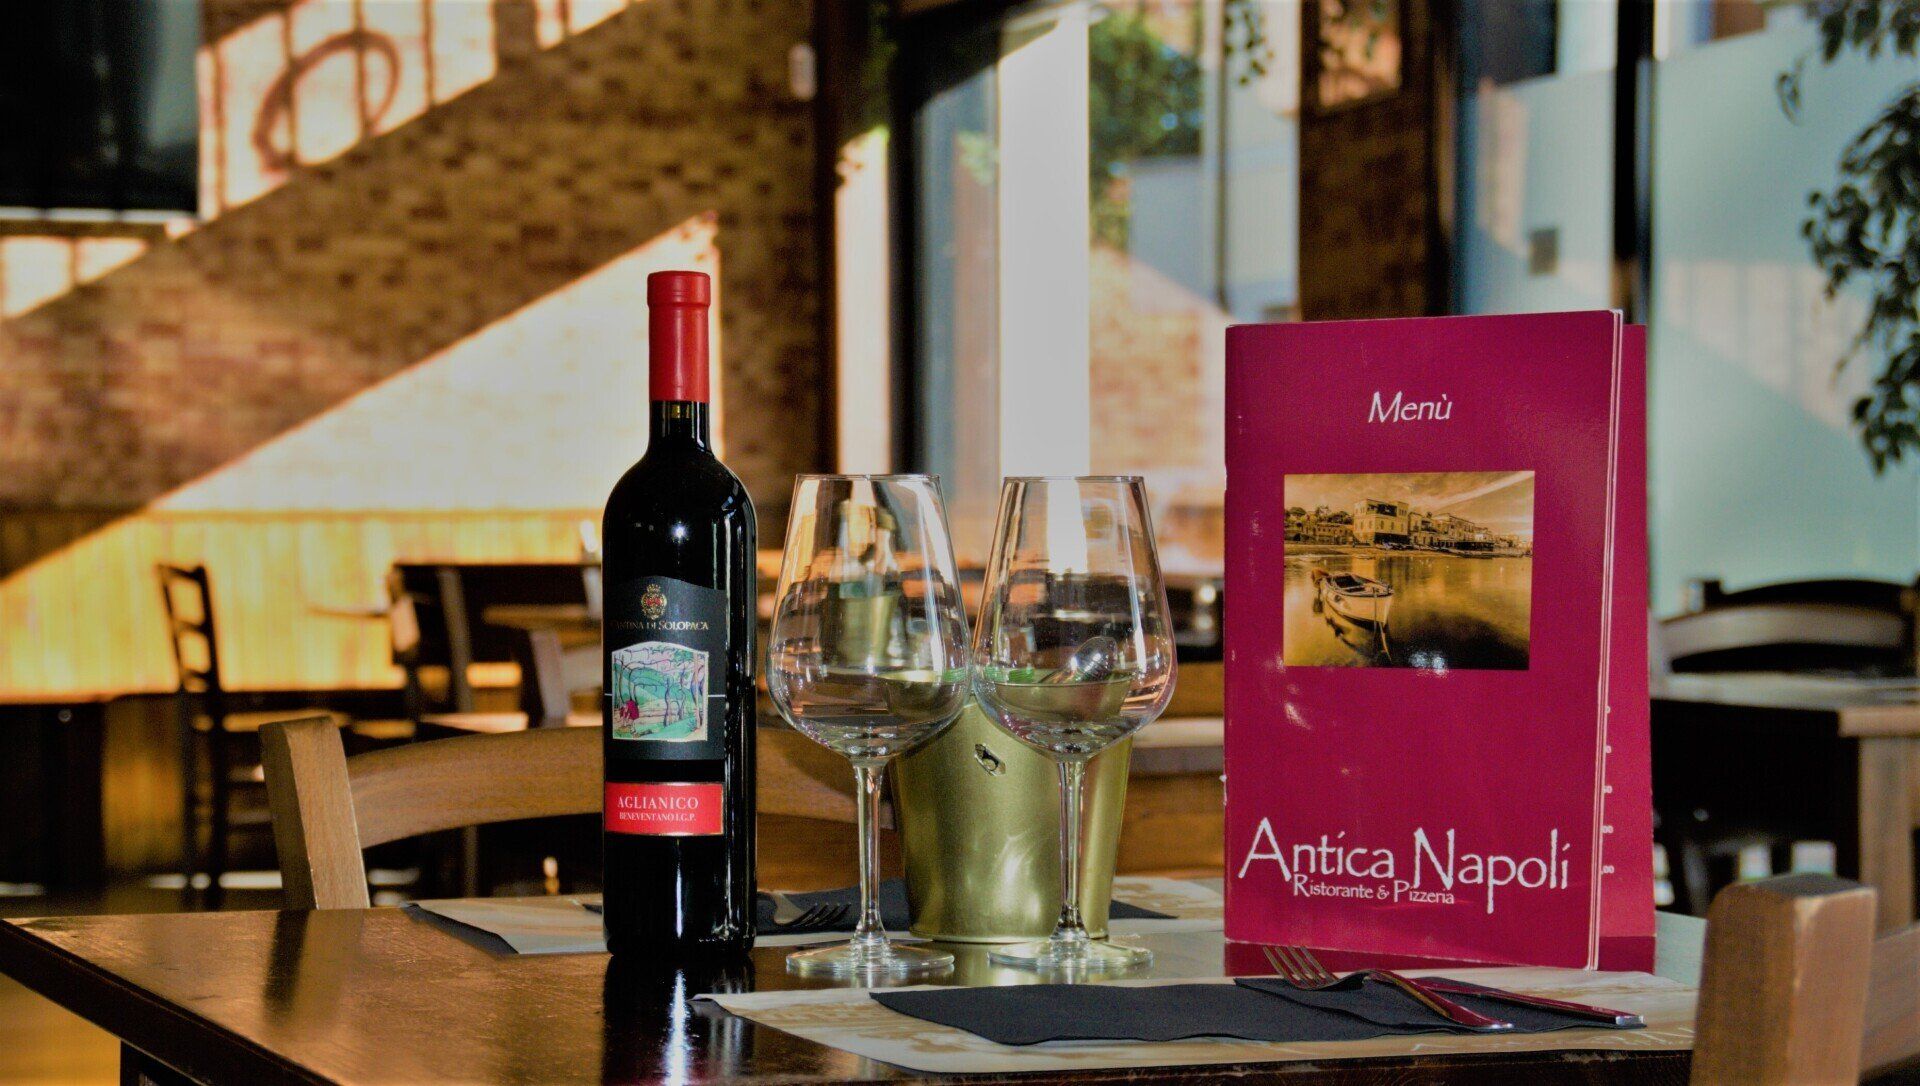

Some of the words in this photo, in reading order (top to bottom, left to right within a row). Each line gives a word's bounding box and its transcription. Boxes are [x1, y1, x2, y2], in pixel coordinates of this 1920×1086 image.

[1368, 390, 1453, 423] Menù
[658, 620, 709, 631] SOLOPACA
[617, 796, 699, 810] AGLIANICO
[1238, 817, 1395, 882] Antica
[1413, 827, 1571, 915] Napoli
[1293, 873, 1374, 898] Ristorante
[1377, 885, 1390, 900] &
[1393, 880, 1455, 905] Pizzeria
